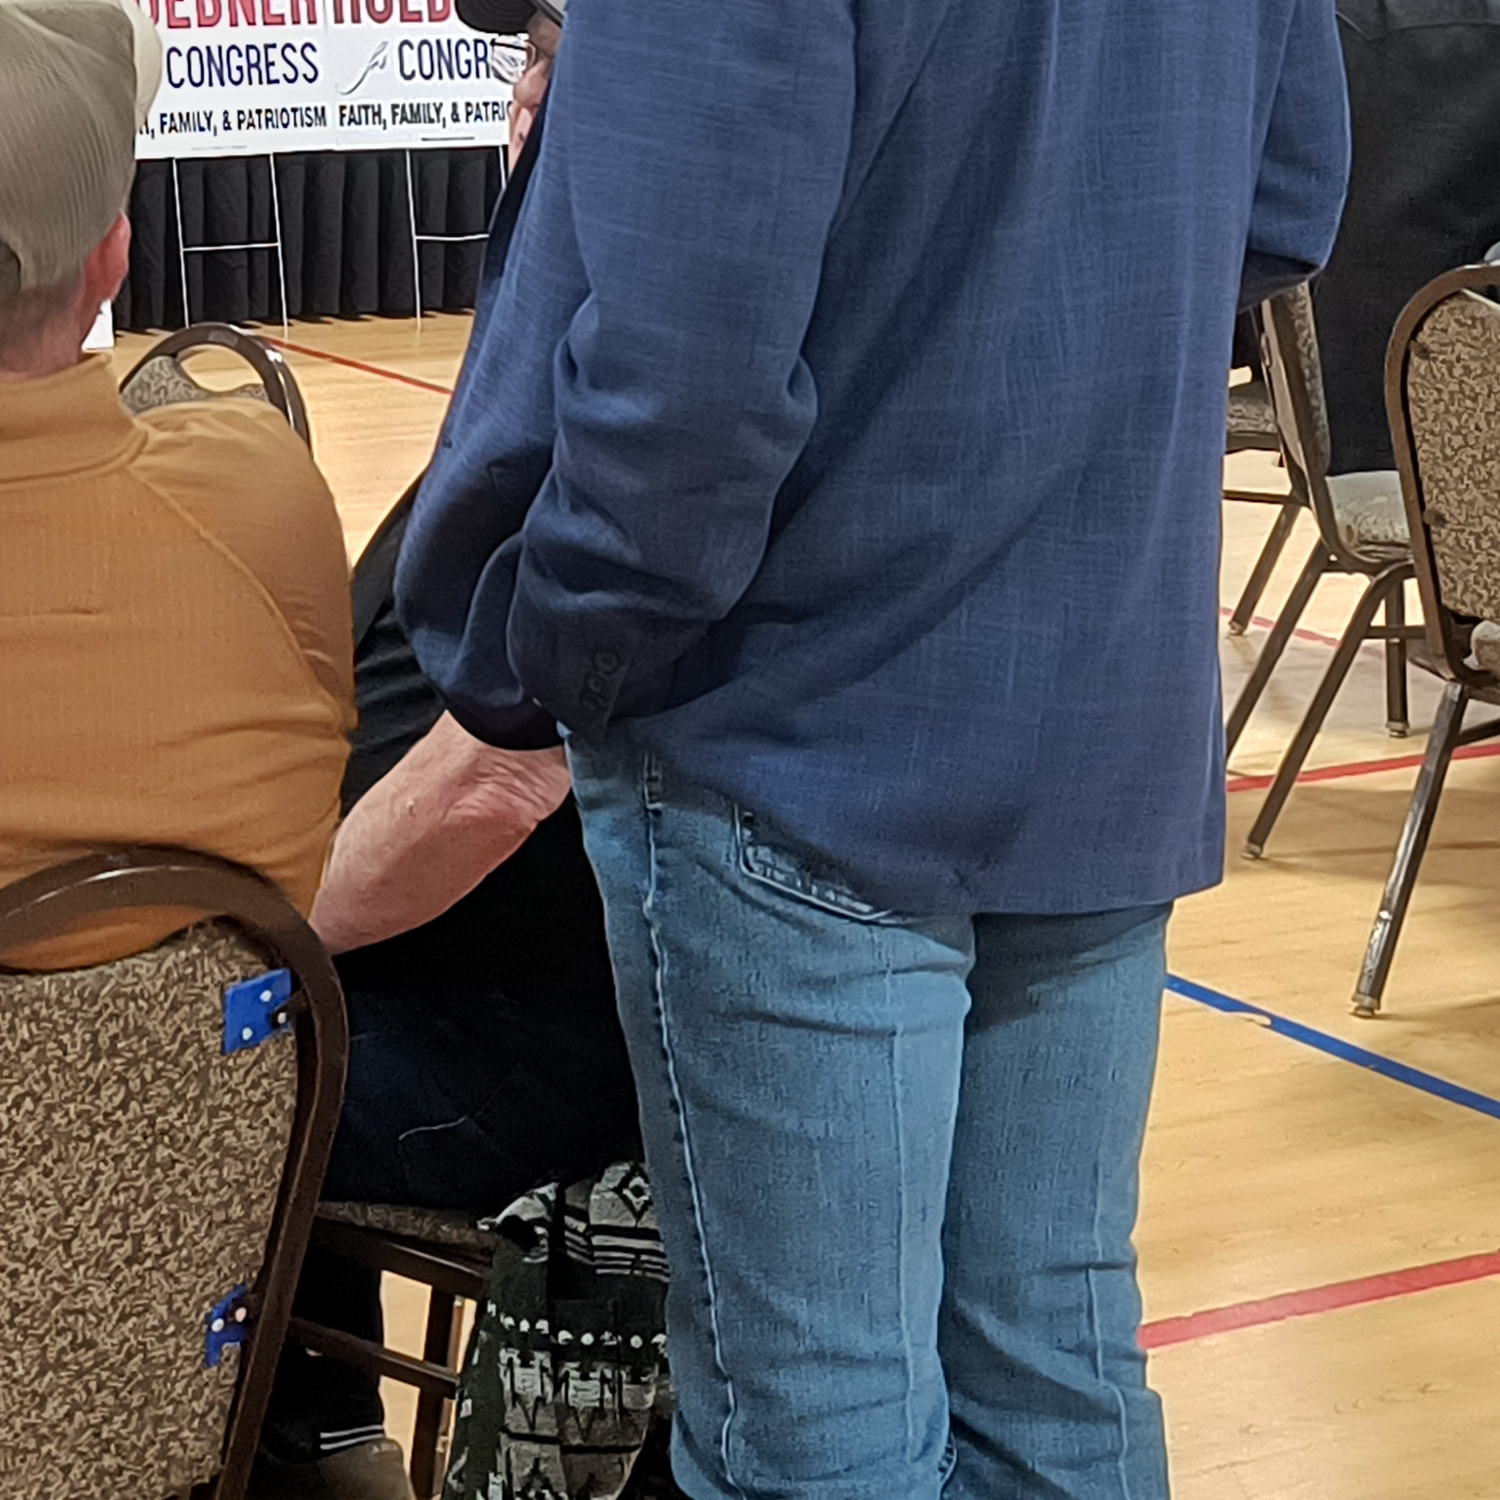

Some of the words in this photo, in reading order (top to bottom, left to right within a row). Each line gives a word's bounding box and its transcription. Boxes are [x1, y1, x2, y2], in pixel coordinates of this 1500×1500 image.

[166, 41, 319, 88] CONGRESS
[398, 38, 491, 81] CONGR
[160, 111, 217, 136] FAMILY,
[223, 110, 232, 131] &
[237, 105, 327, 130] PATRIOTISM
[339, 104, 387, 130] FAITH,
[391, 103, 446, 128] FAMILY,
[450, 102, 460, 123] &
